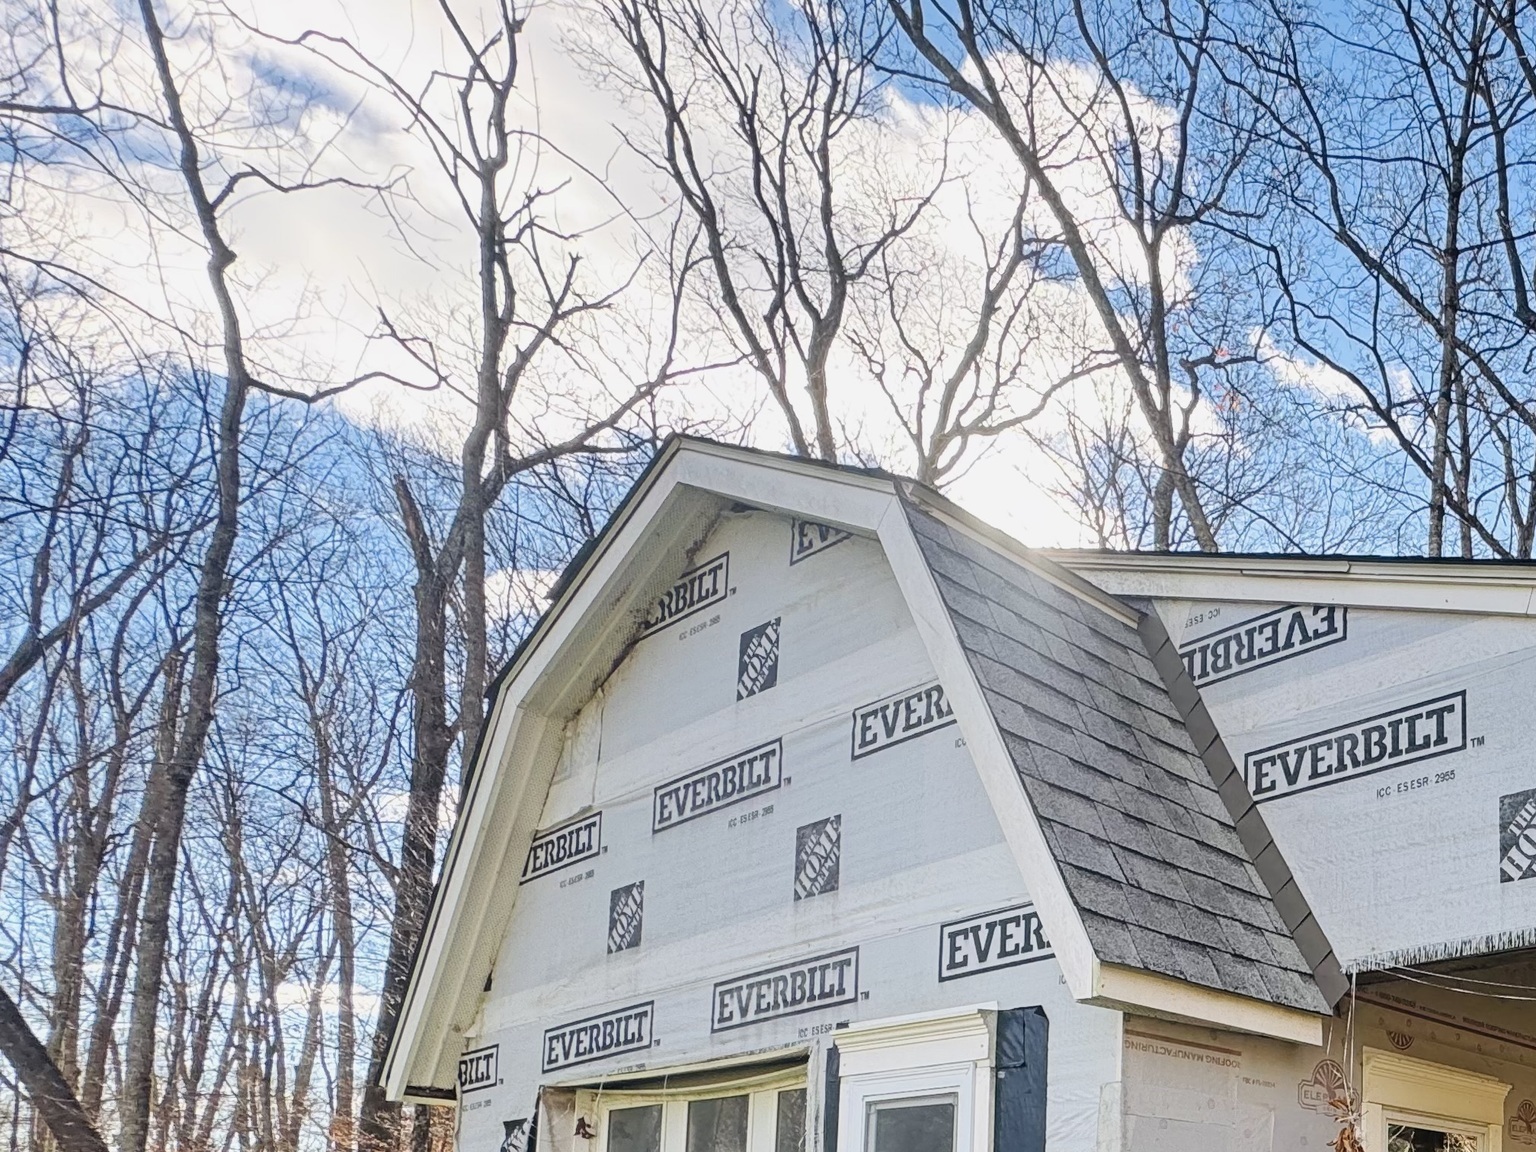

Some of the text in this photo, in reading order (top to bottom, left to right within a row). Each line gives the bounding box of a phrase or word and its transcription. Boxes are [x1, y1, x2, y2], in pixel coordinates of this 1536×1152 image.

[858, 684, 954, 749] EVER
[1253, 704, 1455, 796] EVERBILT
[658, 749, 776, 825] EVERBILT
[947, 911, 1051, 970] EVER
[718, 958, 851, 1024] EVERBILT
[547, 1010, 648, 1065] EVERBILT
